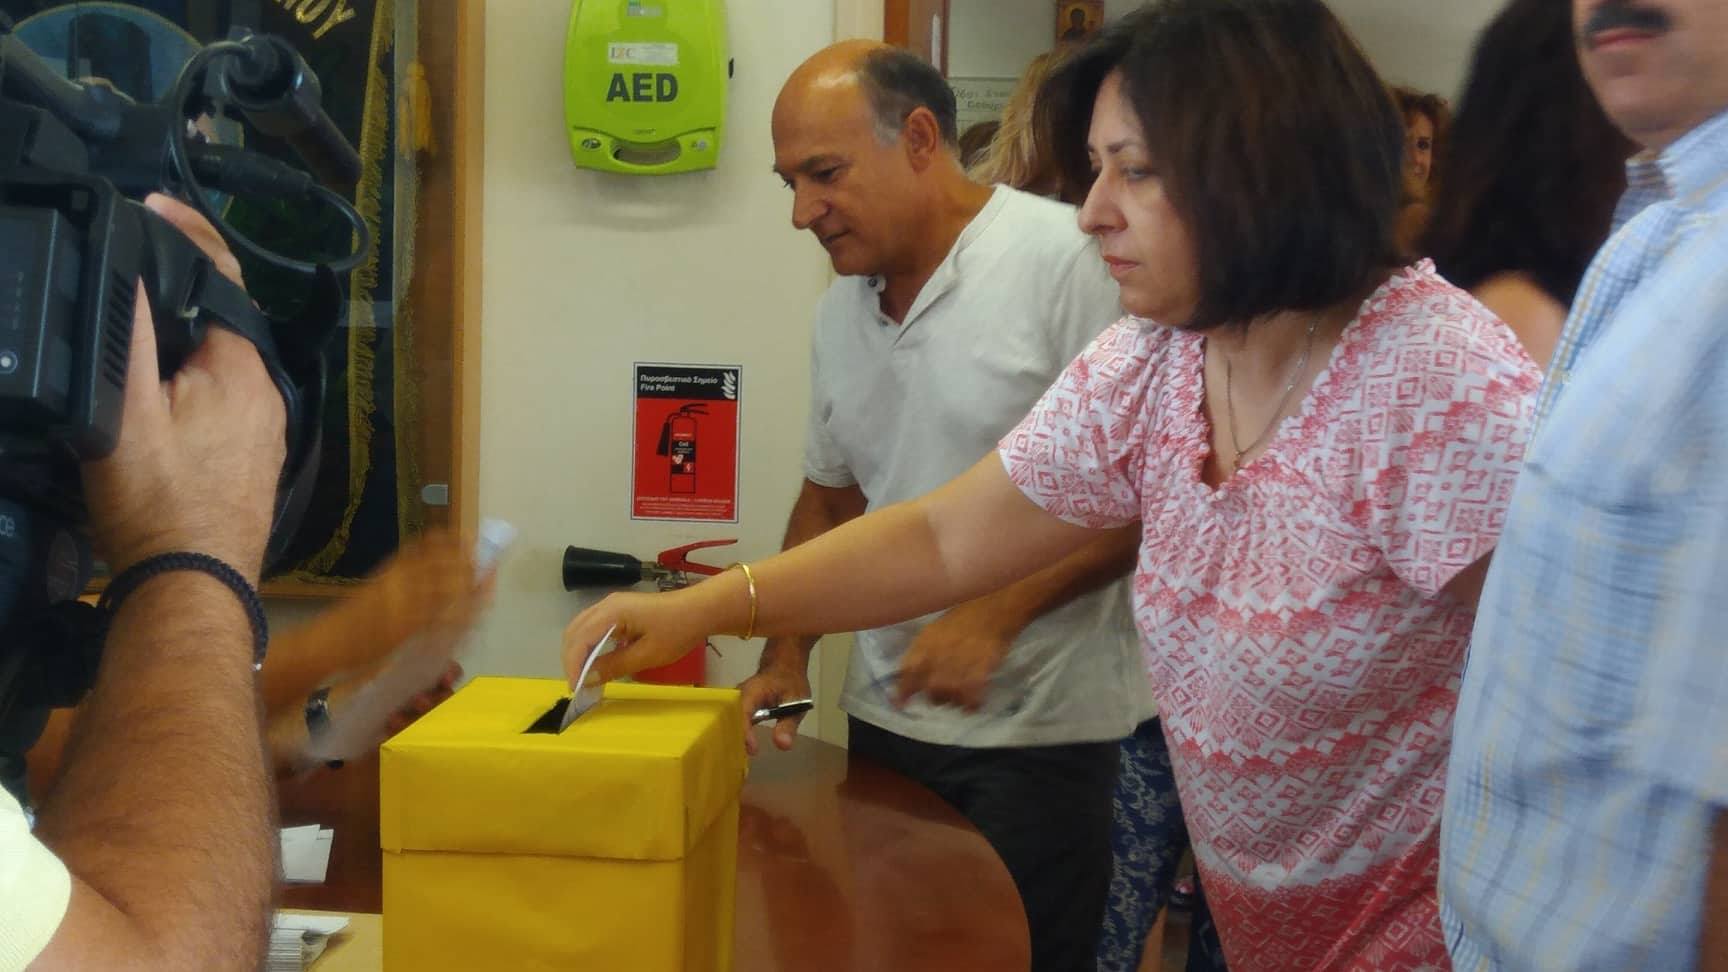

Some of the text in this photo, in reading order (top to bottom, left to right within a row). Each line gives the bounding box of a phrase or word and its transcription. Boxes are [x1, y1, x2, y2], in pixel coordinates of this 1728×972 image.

[606, 72, 679, 102] AED
[640, 383, 675, 391] Fire Point
